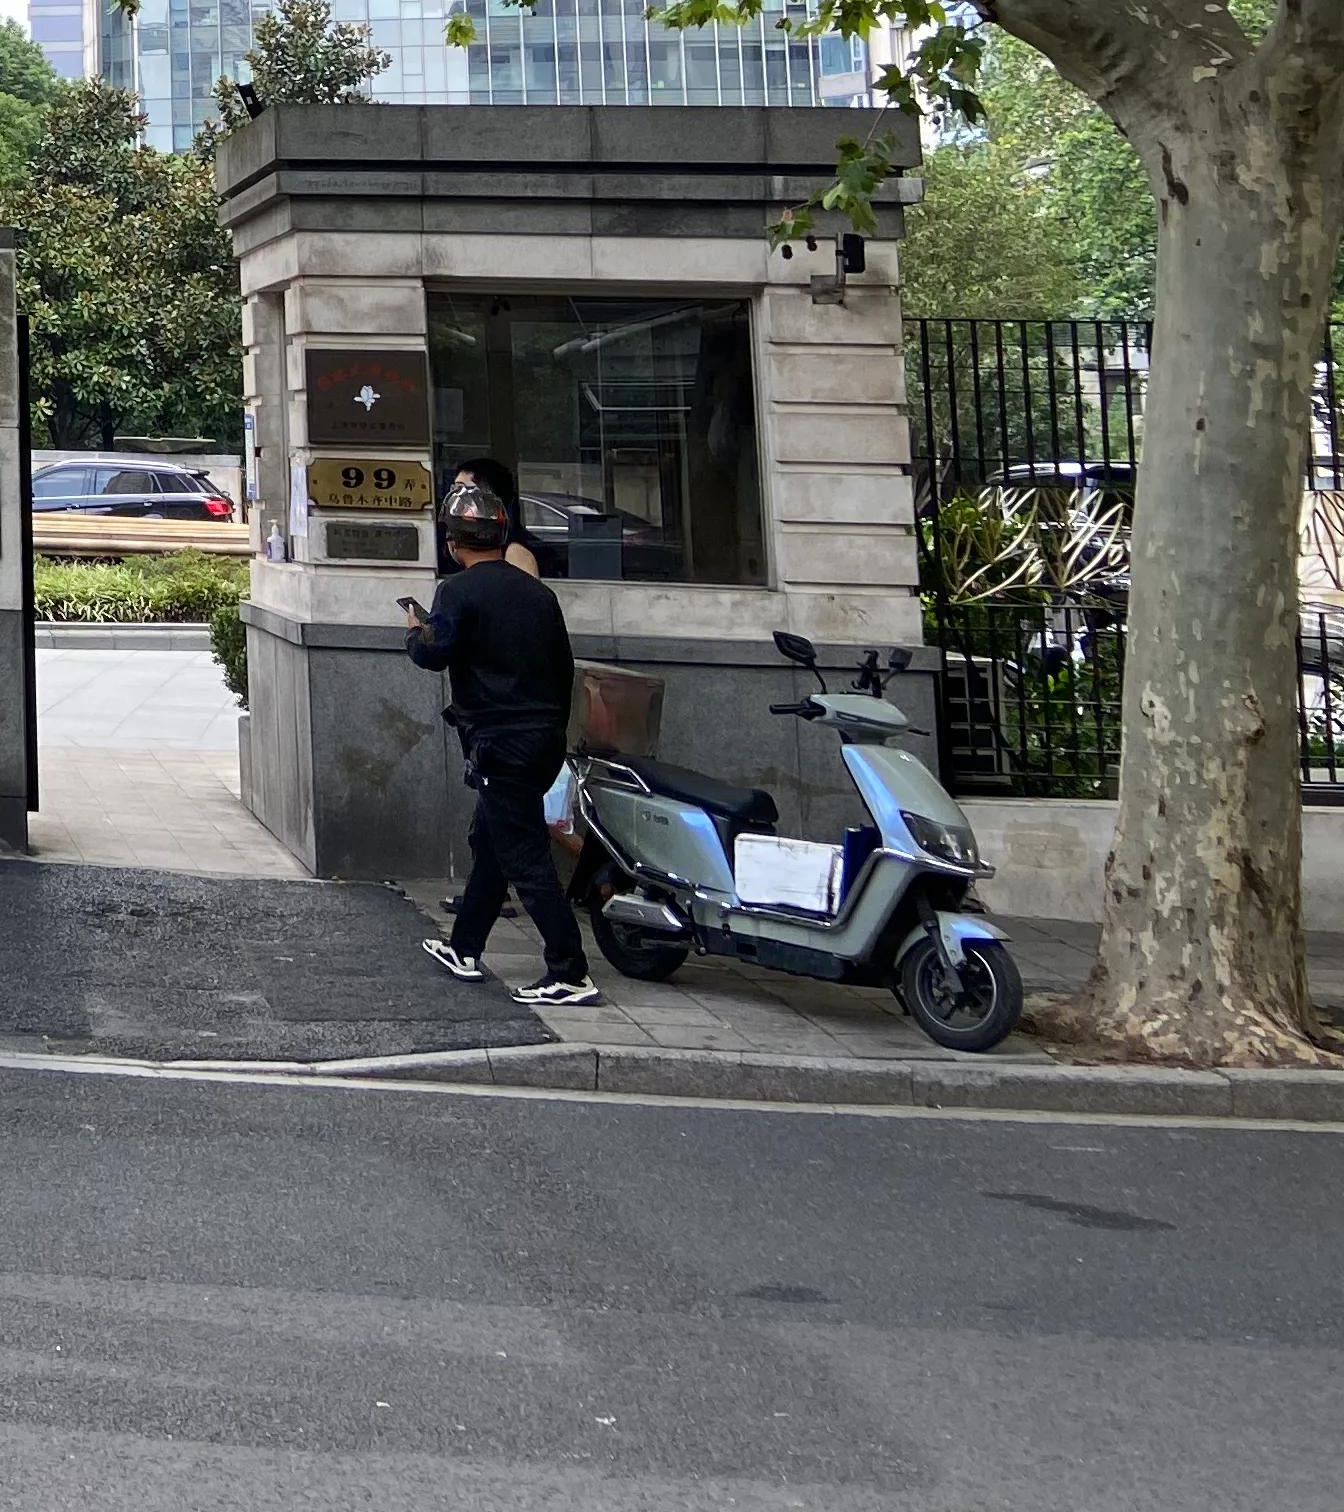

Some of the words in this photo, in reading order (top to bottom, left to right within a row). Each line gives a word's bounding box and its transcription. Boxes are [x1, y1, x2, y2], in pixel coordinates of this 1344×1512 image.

[341, 466, 397, 490] 99
[328, 492, 413, 508] 乌鲁木齐中路
